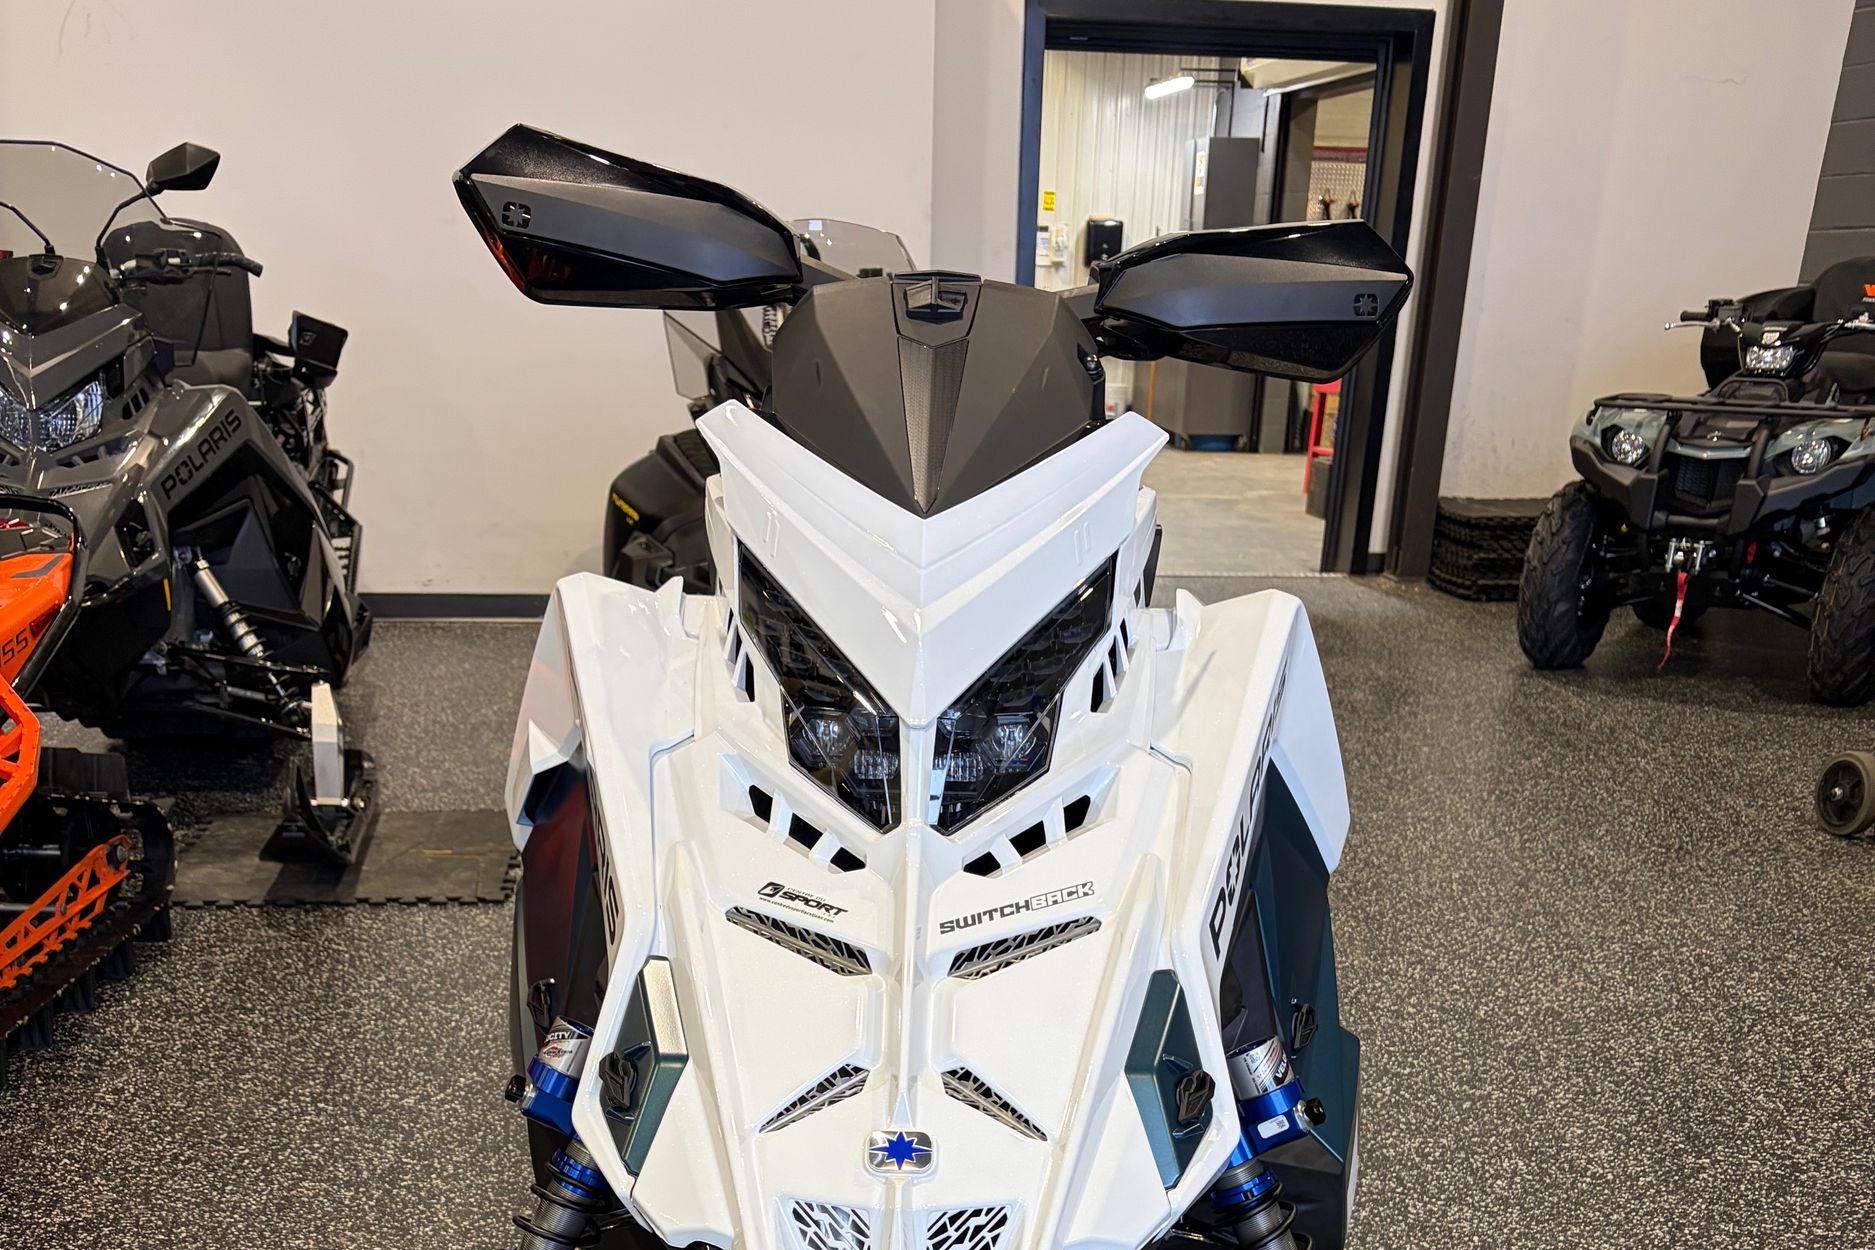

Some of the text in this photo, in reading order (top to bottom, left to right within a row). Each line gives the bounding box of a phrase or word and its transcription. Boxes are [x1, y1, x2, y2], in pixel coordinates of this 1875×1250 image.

[161, 408, 242, 500] POLARIS
[779, 891, 849, 916] SPORT
[939, 881, 1095, 935] SWITCHBACK
